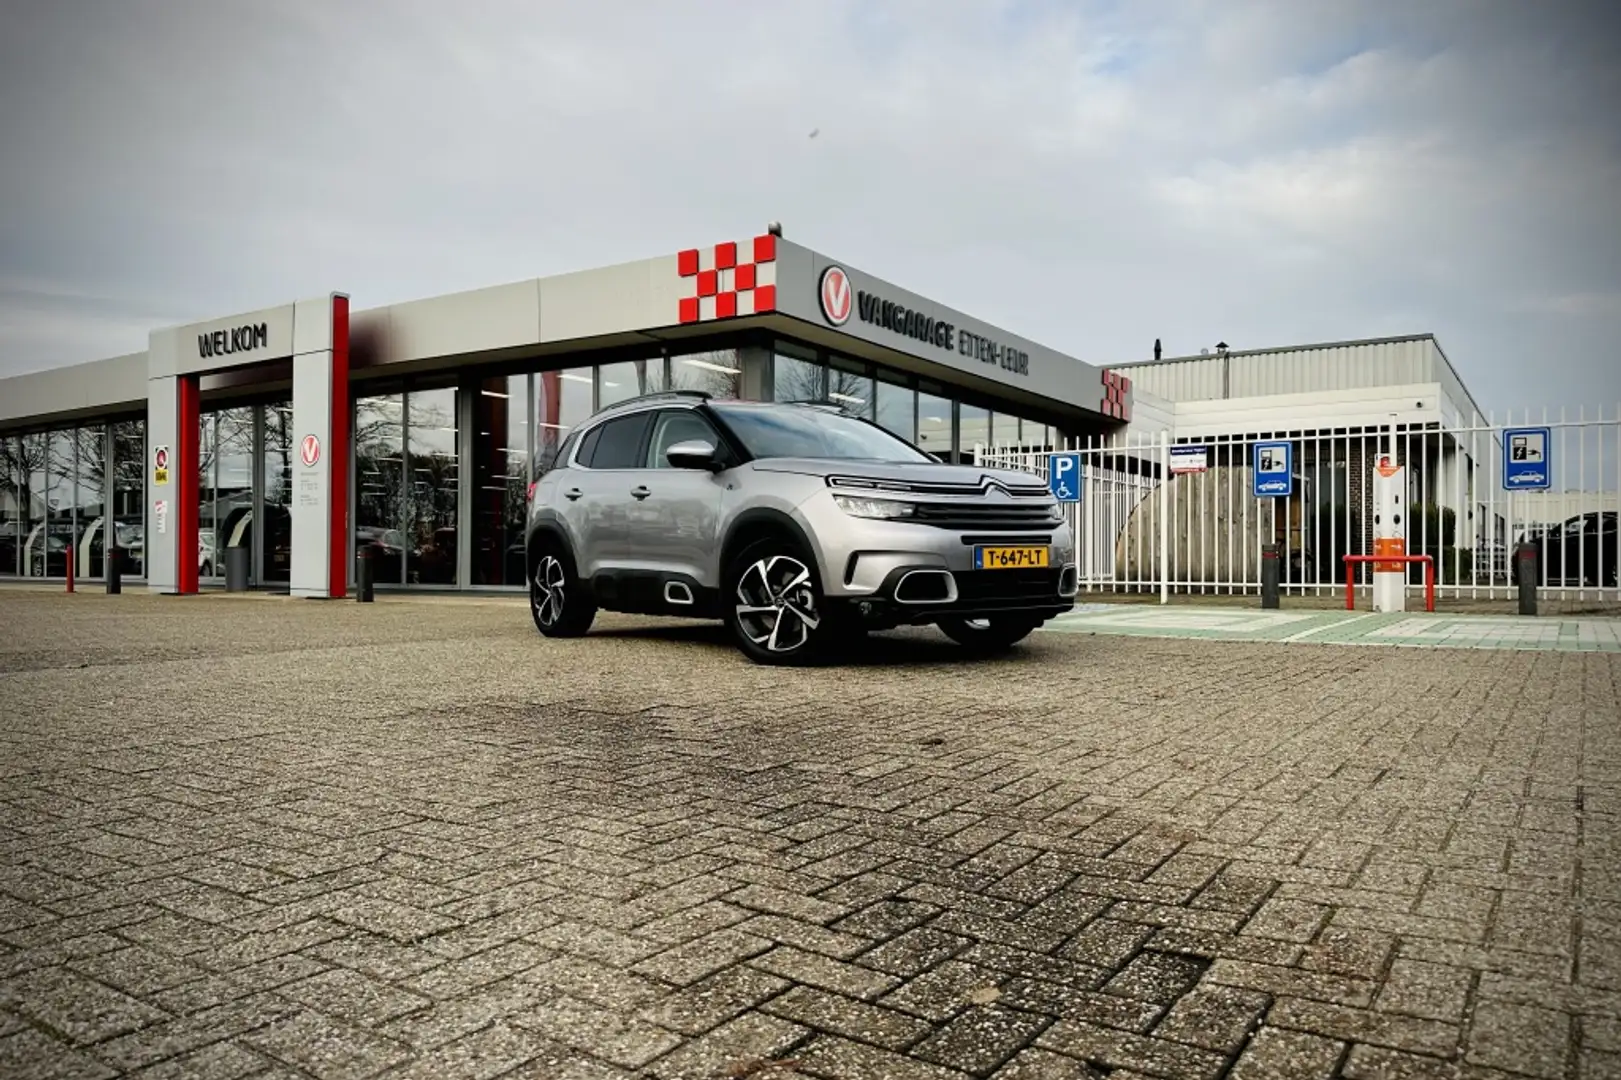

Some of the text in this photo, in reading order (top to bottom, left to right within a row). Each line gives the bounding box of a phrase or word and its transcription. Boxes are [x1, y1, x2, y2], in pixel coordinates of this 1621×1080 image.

[198, 322, 267, 359] WELKOM
[857, 290, 1030, 376] VANGARAGE ETTEN-LEUR
[1056, 457, 1073, 479] P
[988, 549, 1042, 566] T-647-LT
